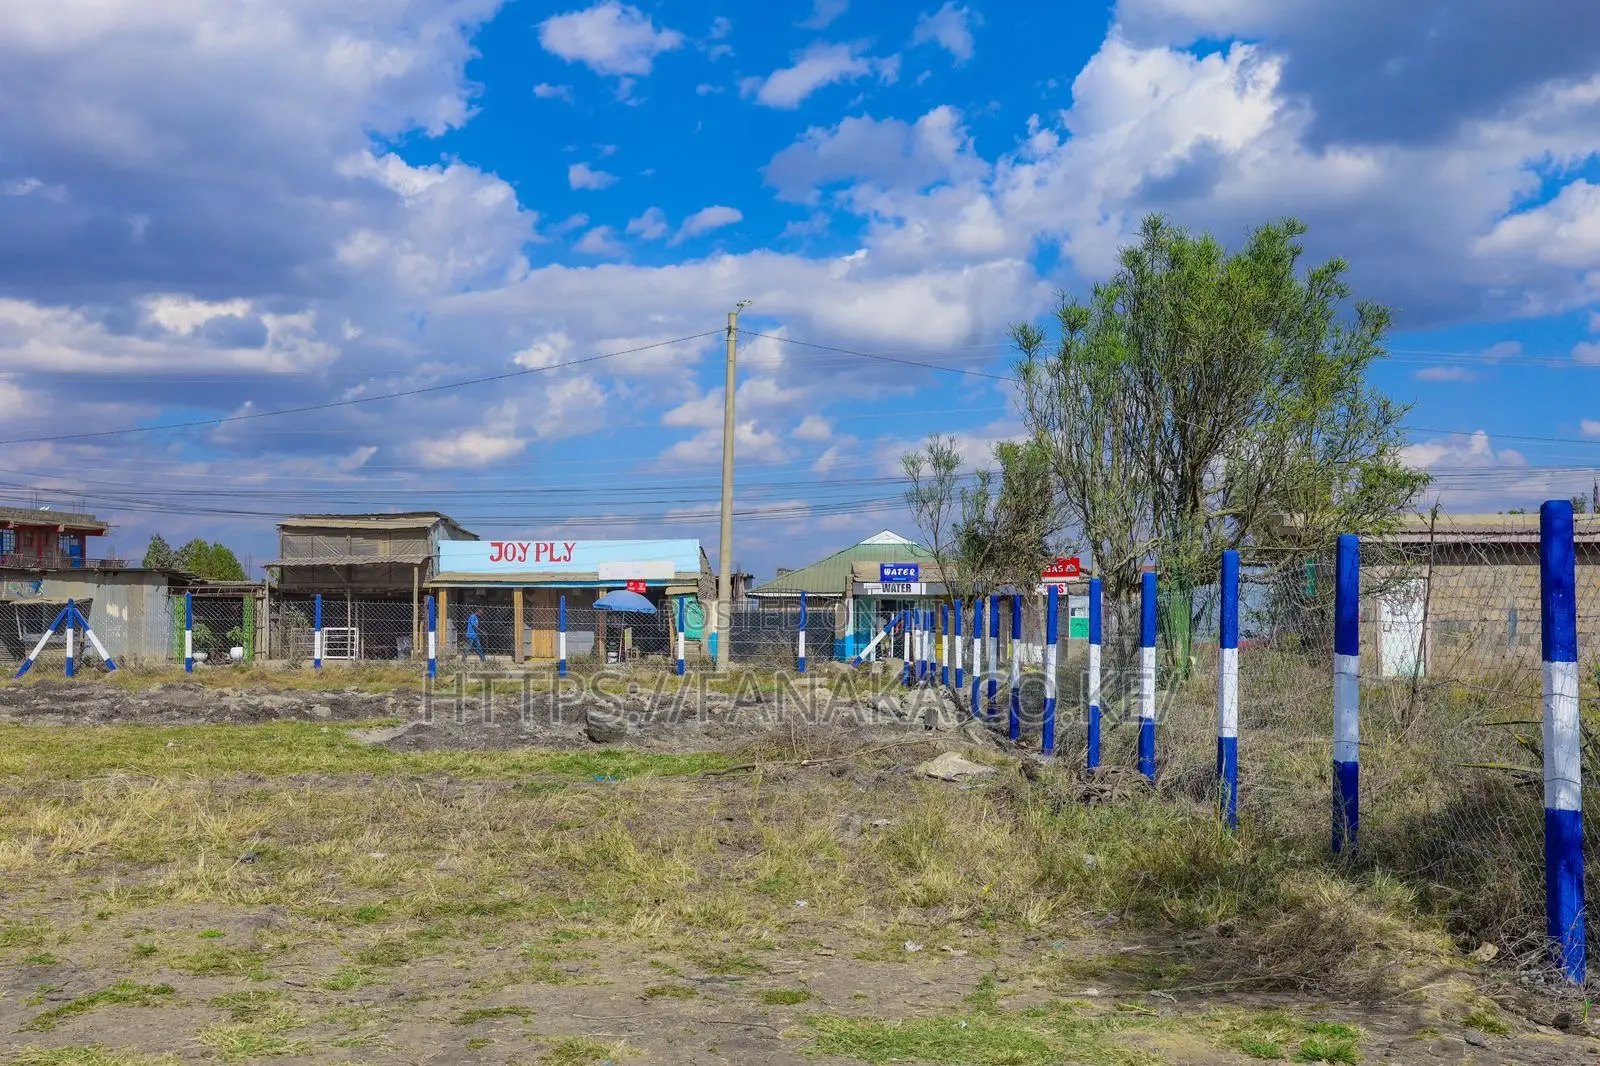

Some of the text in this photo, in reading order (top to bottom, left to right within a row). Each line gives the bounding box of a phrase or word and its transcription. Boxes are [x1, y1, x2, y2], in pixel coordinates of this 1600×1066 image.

[490, 542, 576, 562] JOY PLY
[884, 568, 915, 576] WATER
[882, 583, 912, 593] WATER
